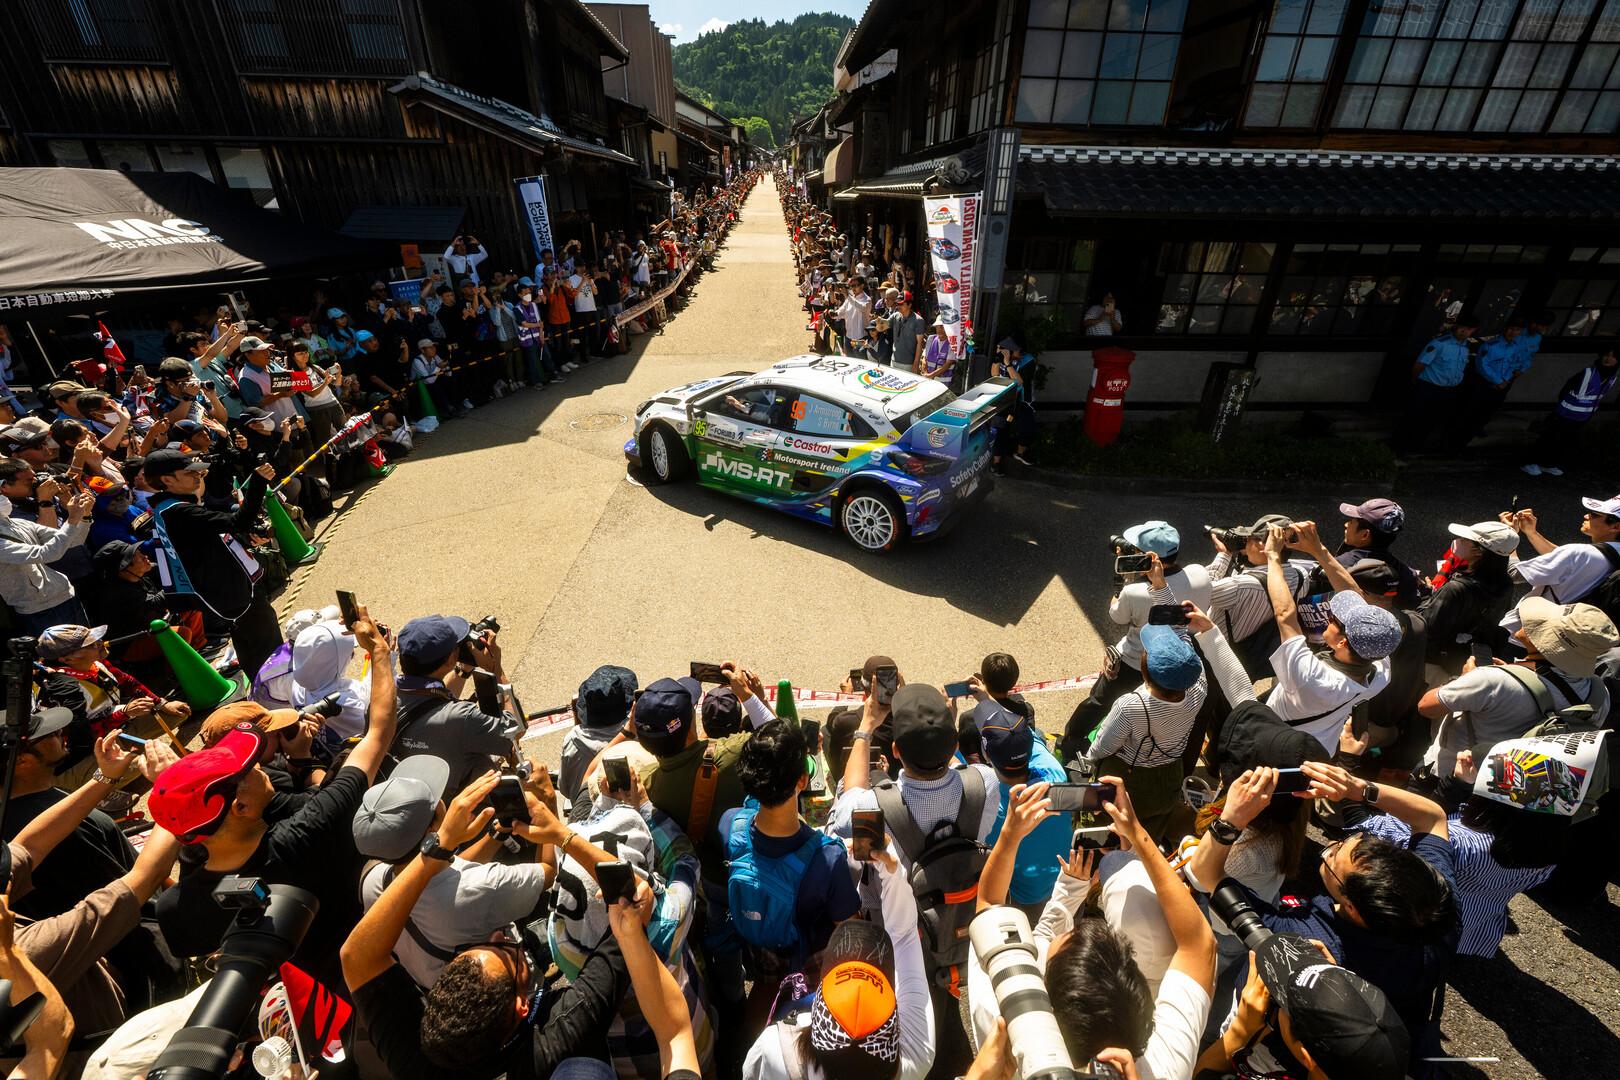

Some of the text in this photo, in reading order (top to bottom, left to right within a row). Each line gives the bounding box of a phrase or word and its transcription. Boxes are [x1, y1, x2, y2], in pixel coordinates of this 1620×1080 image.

[790, 400, 807, 421] 95
[695, 420, 706, 436] 95
[793, 439, 832, 454] Castrol
[774, 453, 850, 475] Motorsport Ireland
[950, 450, 991, 488] SafetyCultur
[1300, 611, 1329, 621] RALLY
